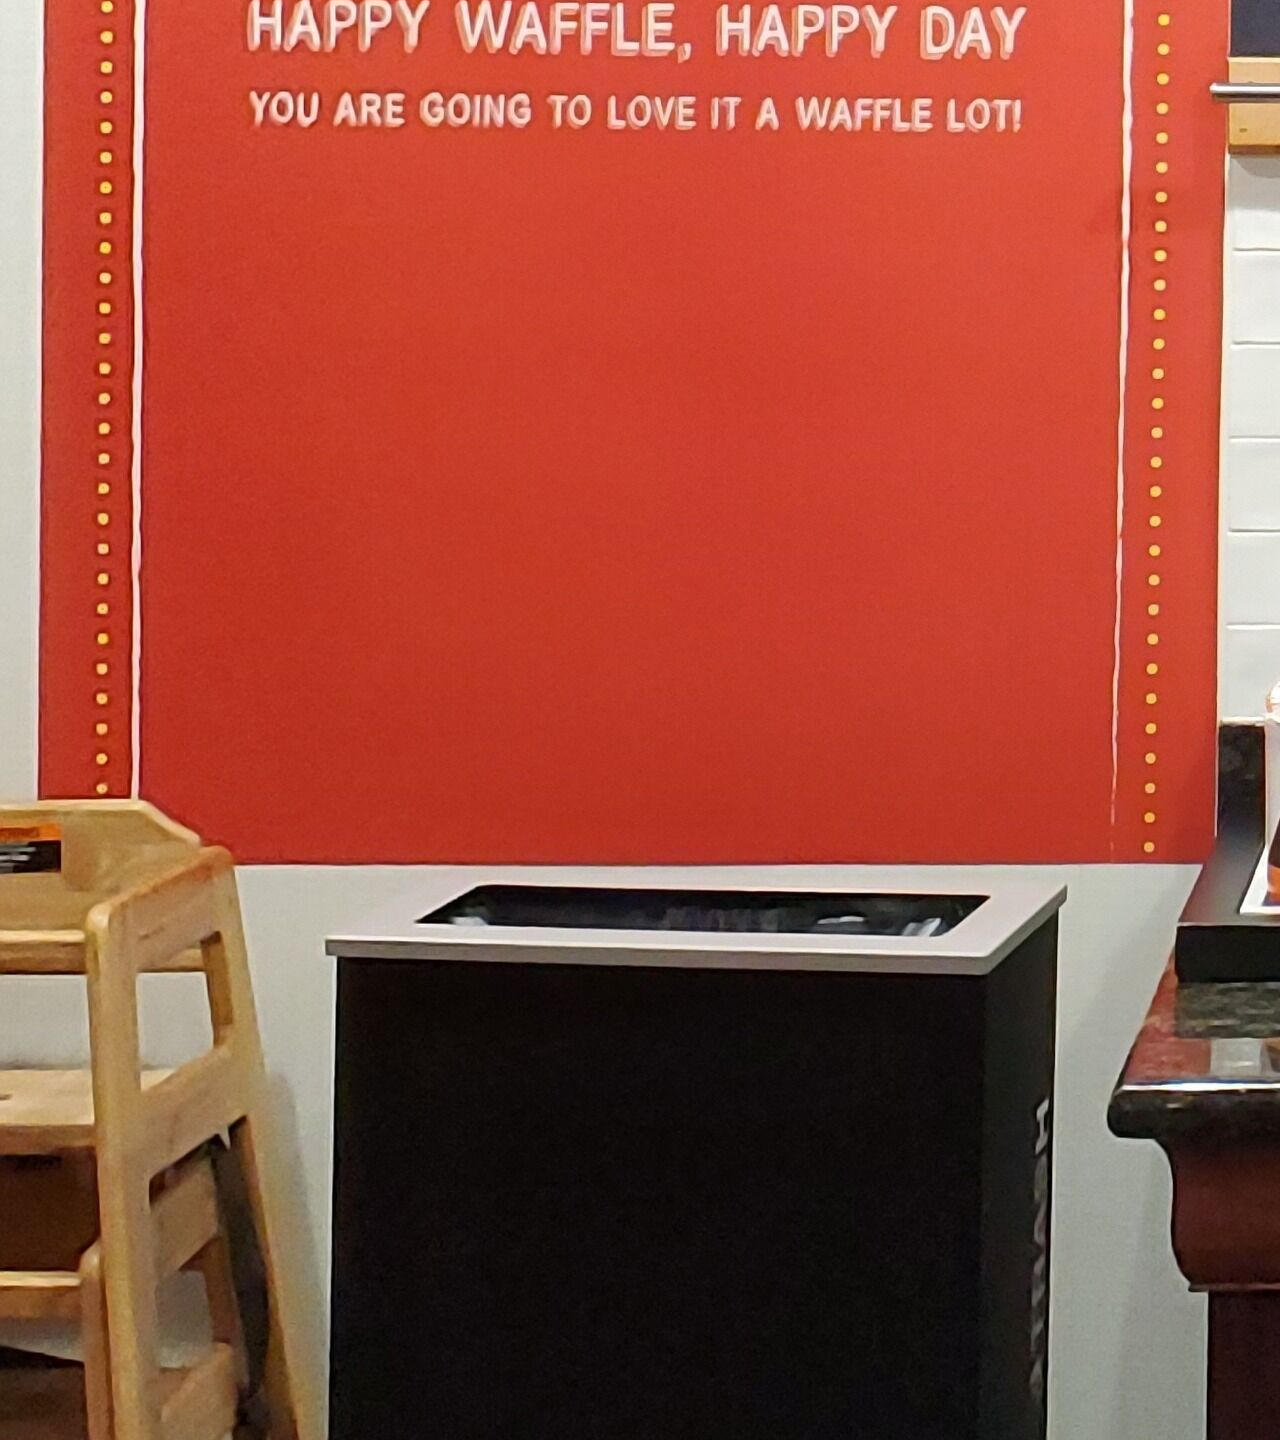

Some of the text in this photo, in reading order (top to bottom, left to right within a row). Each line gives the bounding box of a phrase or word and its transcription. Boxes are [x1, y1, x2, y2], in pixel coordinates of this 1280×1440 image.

[715, 4, 898, 60] HAPPY
[919, 6, 1026, 61] DAY
[248, 91, 1023, 133] YOU ARE GOING TO LOVE IT A WAFFLE LOT!
